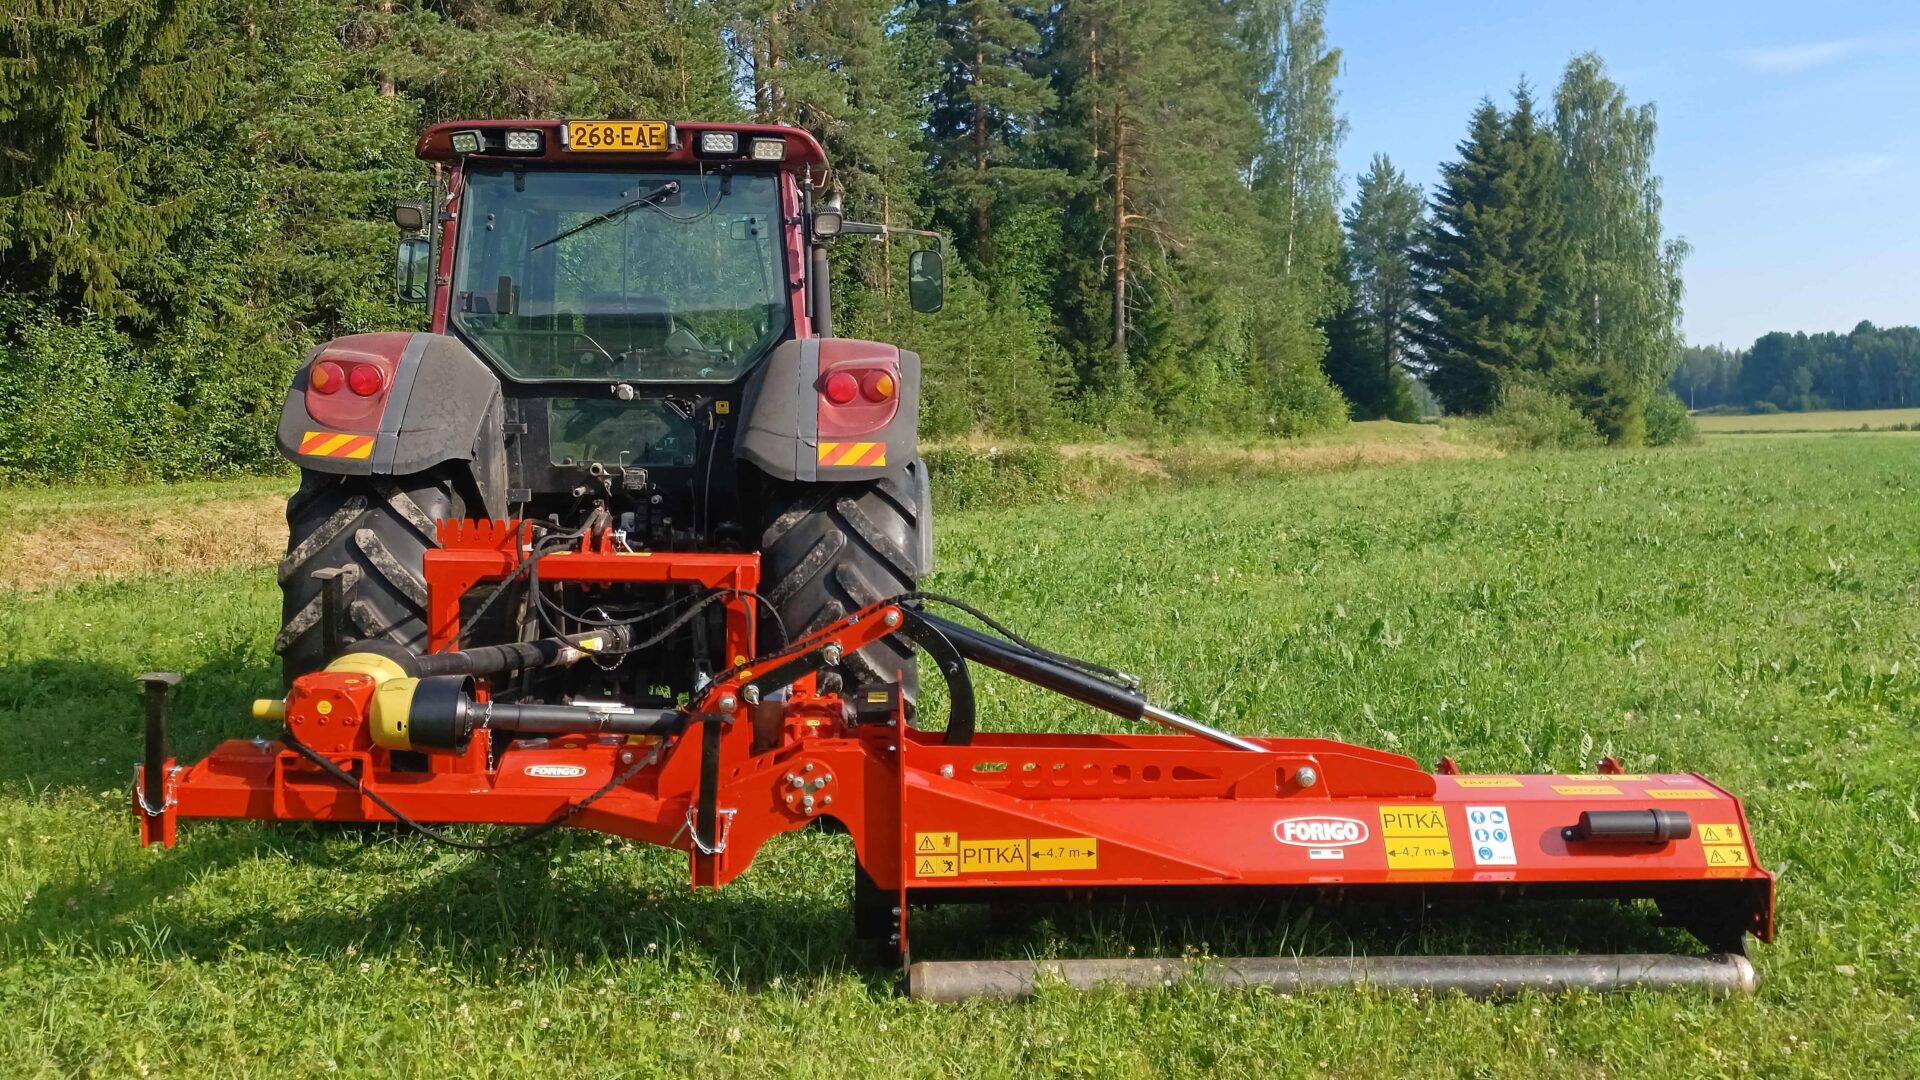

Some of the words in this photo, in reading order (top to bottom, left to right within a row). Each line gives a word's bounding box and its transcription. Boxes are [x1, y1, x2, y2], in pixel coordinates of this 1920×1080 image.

[530, 767, 580, 776] FORIGO
[1383, 811, 1444, 829] PITKÄ
[1284, 822, 1359, 841] FORIGO
[963, 844, 1024, 864] PITKÄ
[1046, 847, 1065, 859] 4,7
[1069, 848, 1080, 857] m
[1402, 847, 1419, 858] 4,7
[1424, 848, 1436, 857] m
